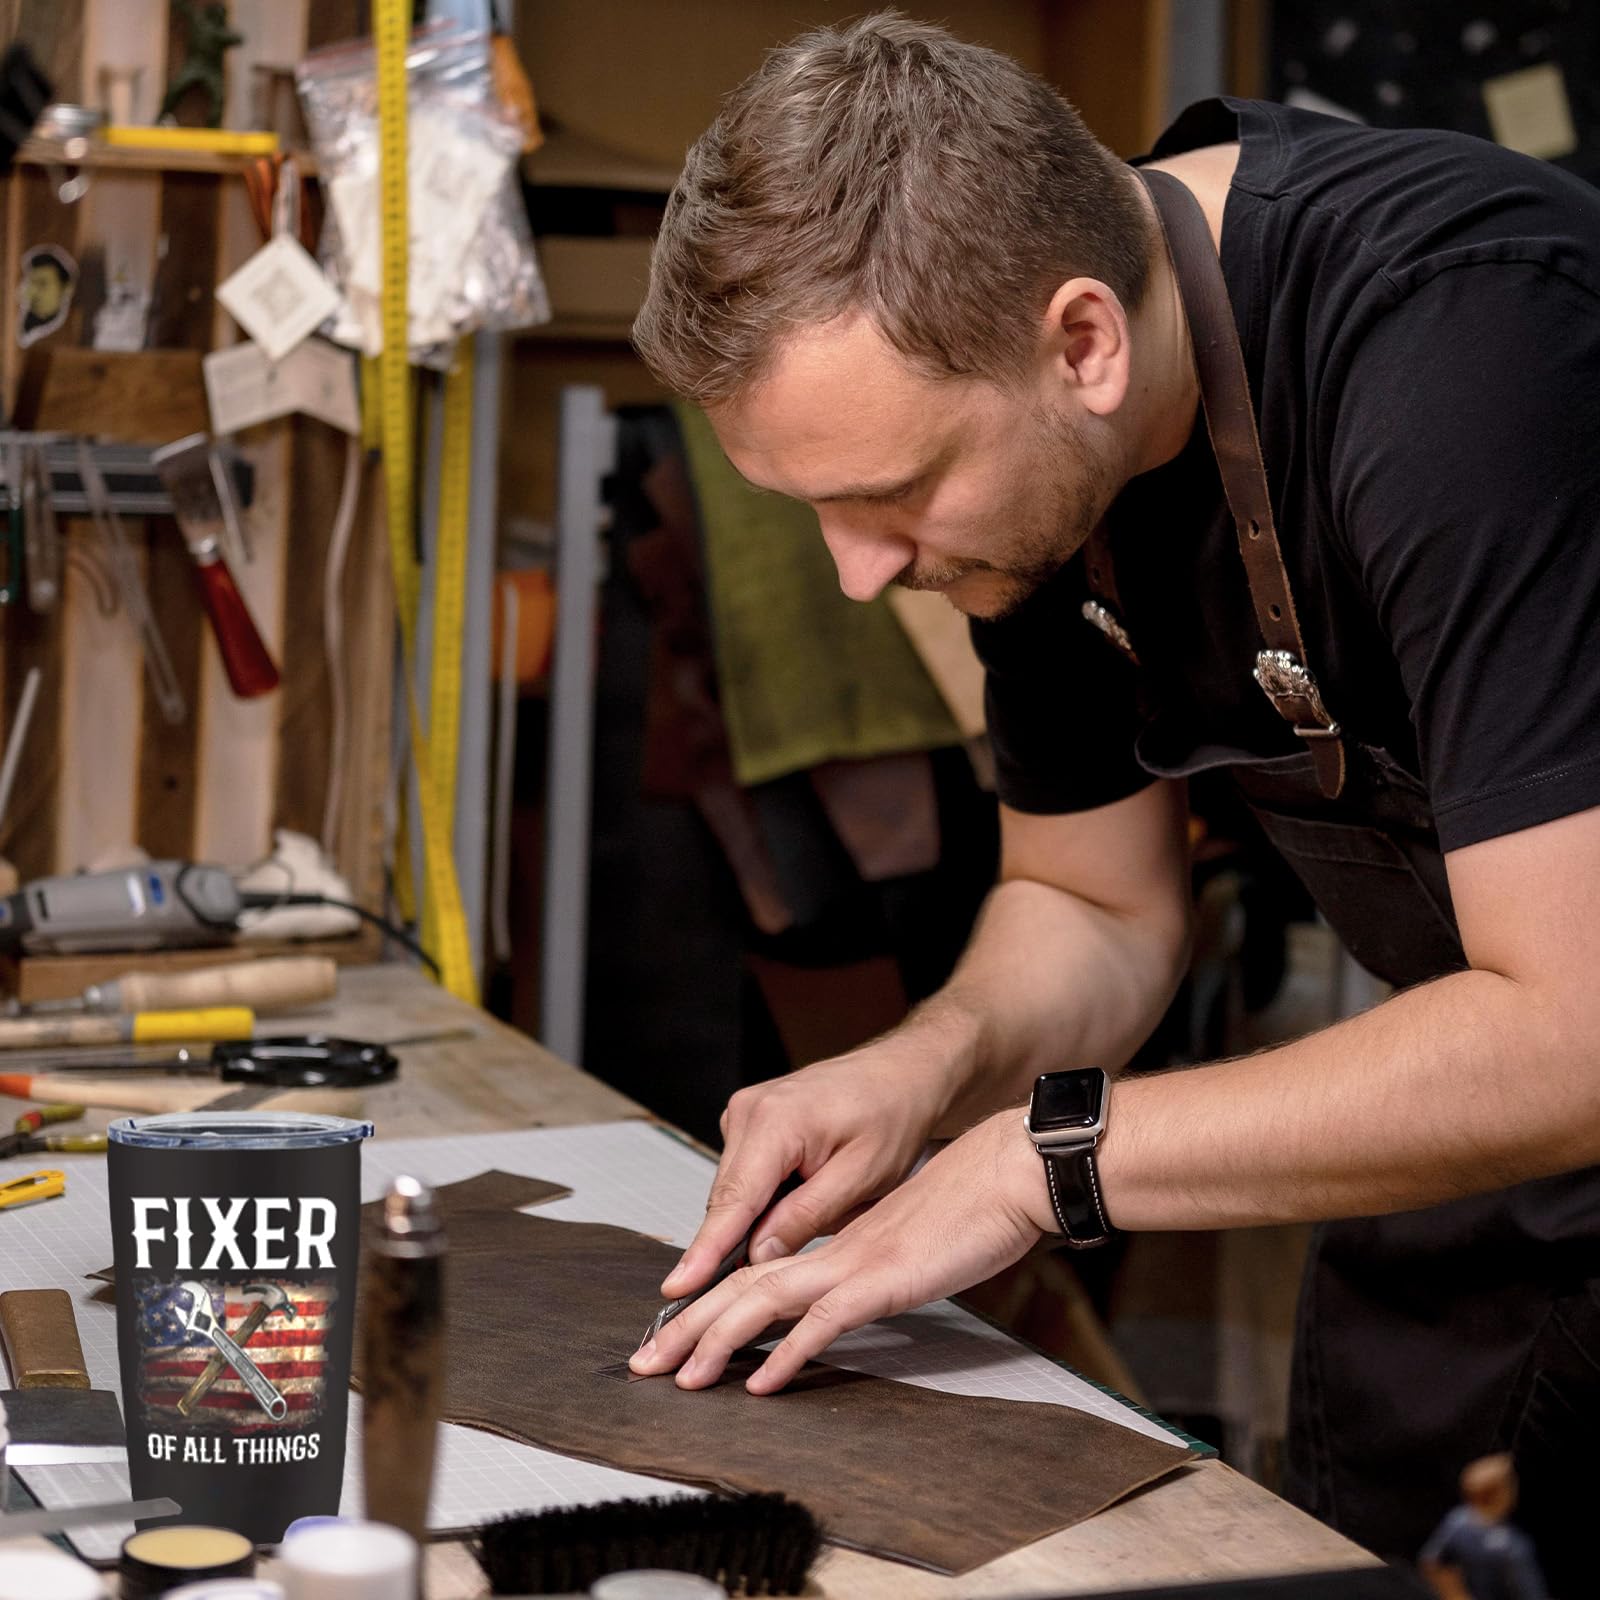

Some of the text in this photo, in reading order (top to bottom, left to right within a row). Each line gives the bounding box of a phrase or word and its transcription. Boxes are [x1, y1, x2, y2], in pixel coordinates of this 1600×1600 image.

[131, 1197, 338, 1270] FIXER
[147, 1432, 321, 1465] OF ALL THINGS
